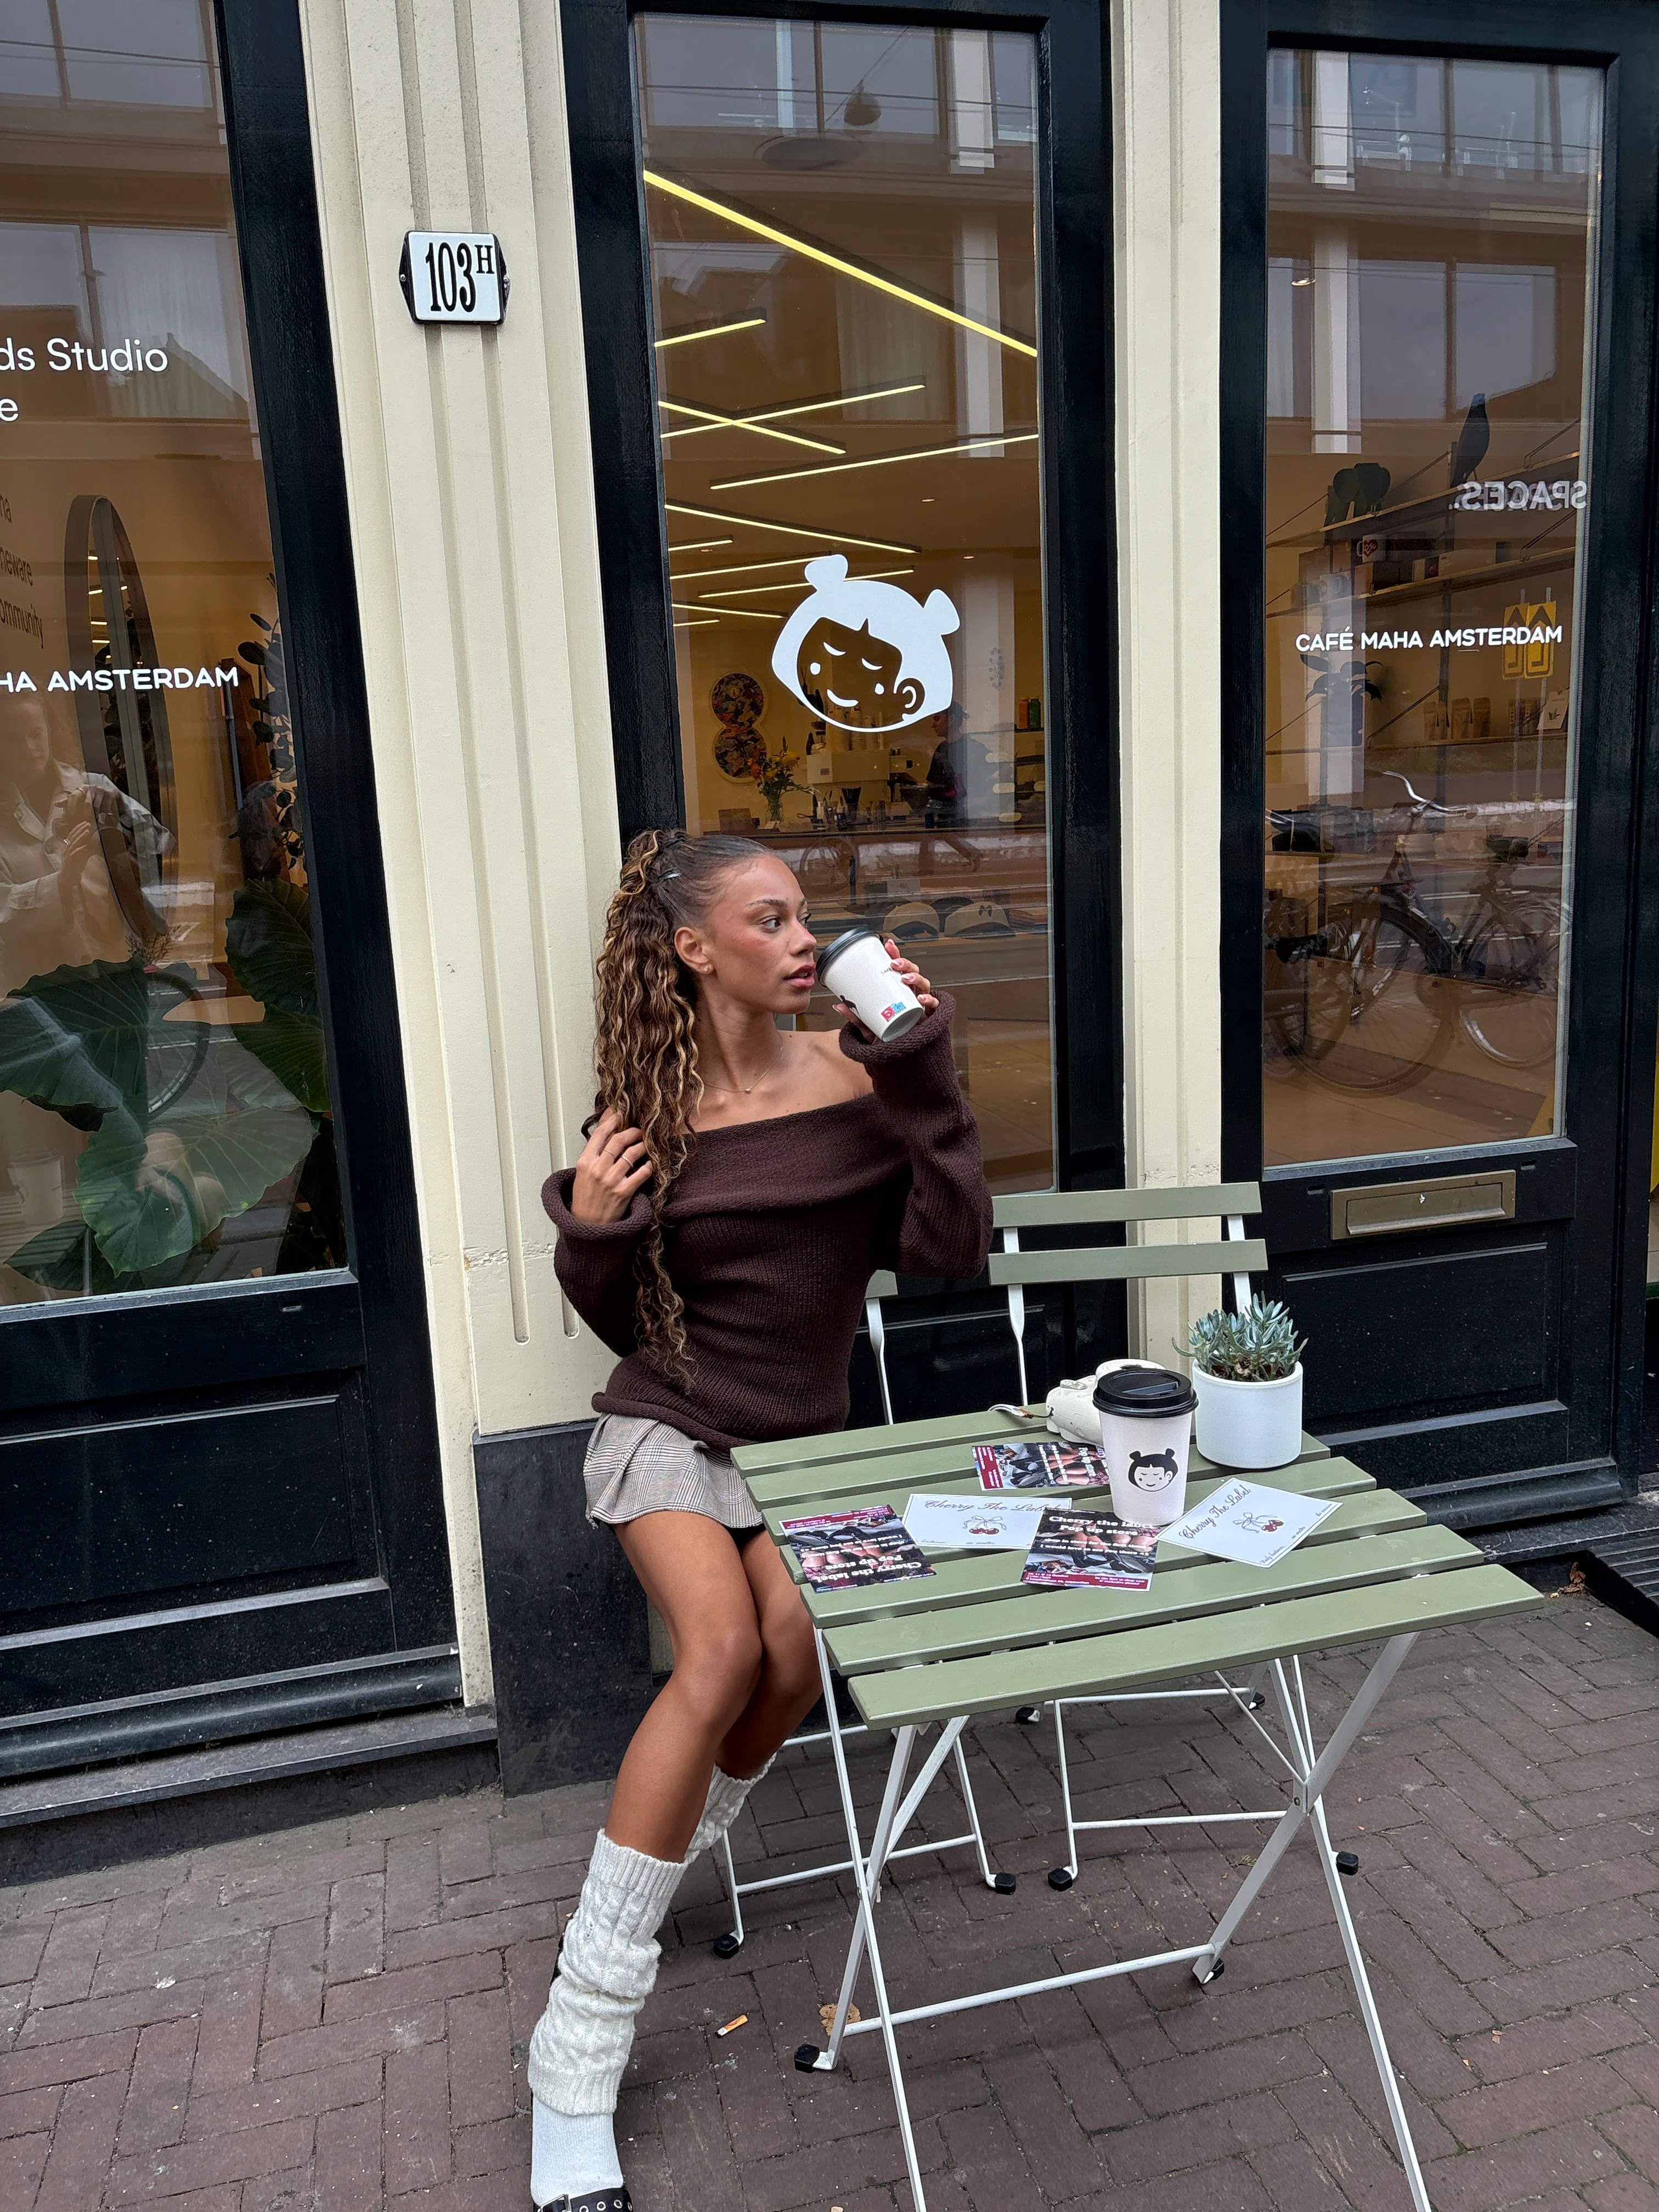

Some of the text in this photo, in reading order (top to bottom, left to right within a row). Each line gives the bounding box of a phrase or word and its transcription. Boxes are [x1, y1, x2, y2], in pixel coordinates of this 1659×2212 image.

[48, 338, 168, 371] Studio
[1296, 625, 1562, 652] CAFÉ MAHA AMSTERDAM
[47, 667, 239, 692] AMSTERDAM
[925, 1500, 974, 1511] Cherry
[978, 1502, 1008, 1510] The
[1178, 1484, 1251, 1539] Cherry The Label
[1049, 1516, 1094, 1525] Cherry
[825, 1561, 856, 1570] store
[877, 1561, 922, 1572] Cherry
[816, 1572, 850, 1582] label
